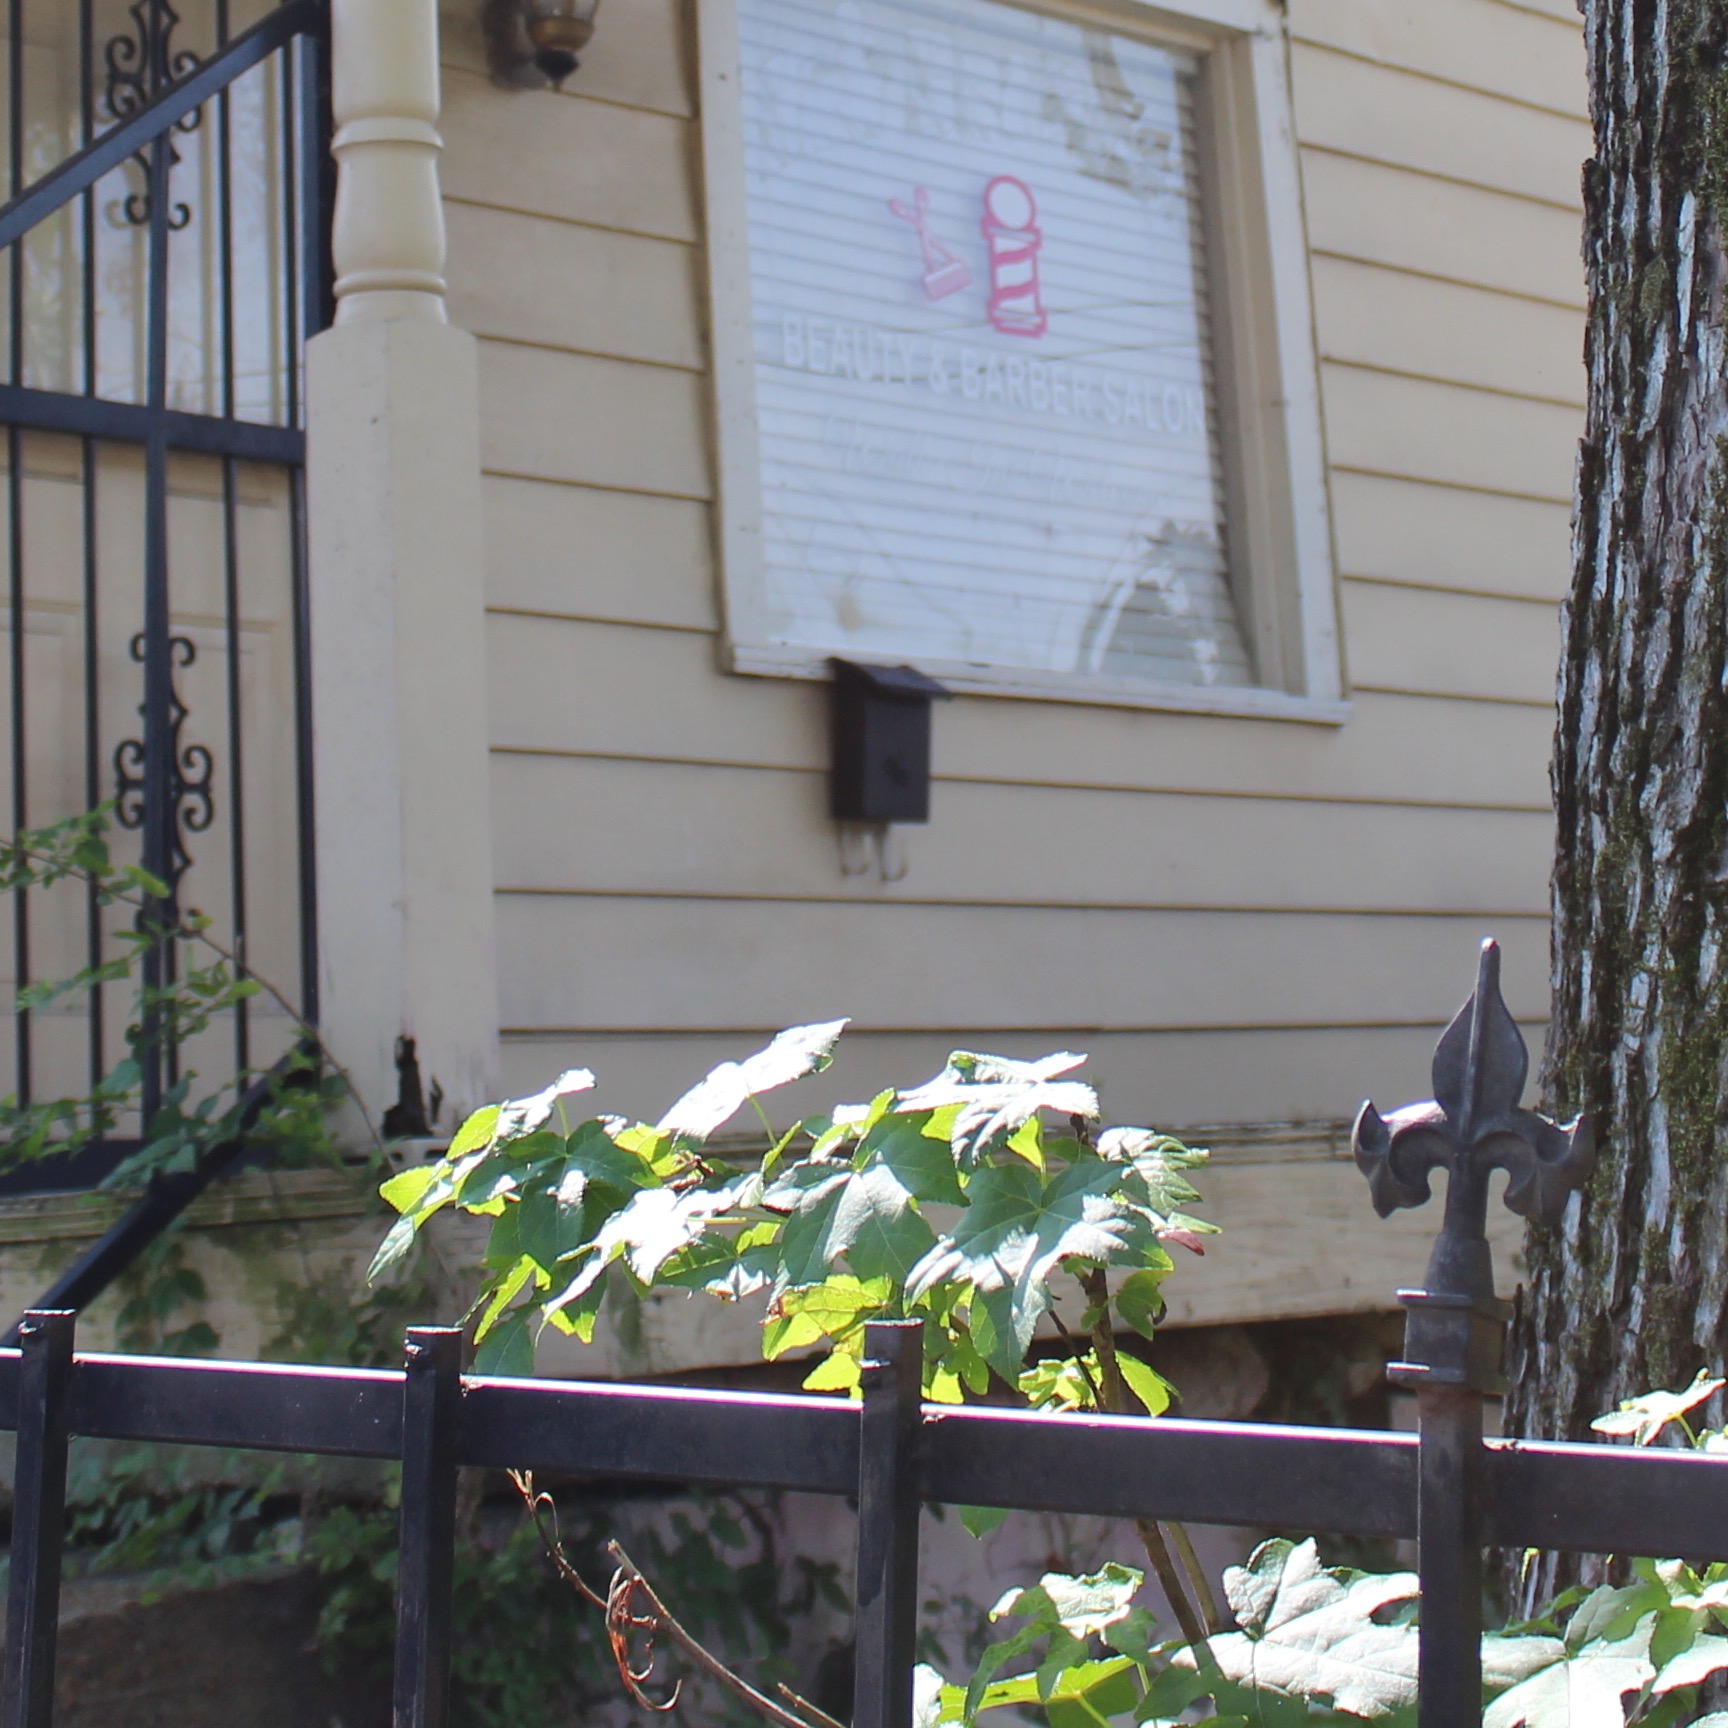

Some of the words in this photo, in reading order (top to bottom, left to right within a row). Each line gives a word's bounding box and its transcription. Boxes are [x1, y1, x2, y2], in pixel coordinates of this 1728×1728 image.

[781, 313, 916, 386] BEAUTY
[927, 350, 951, 394] &
[960, 347, 1092, 418] BARBER
[1104, 374, 1205, 436] SALON
